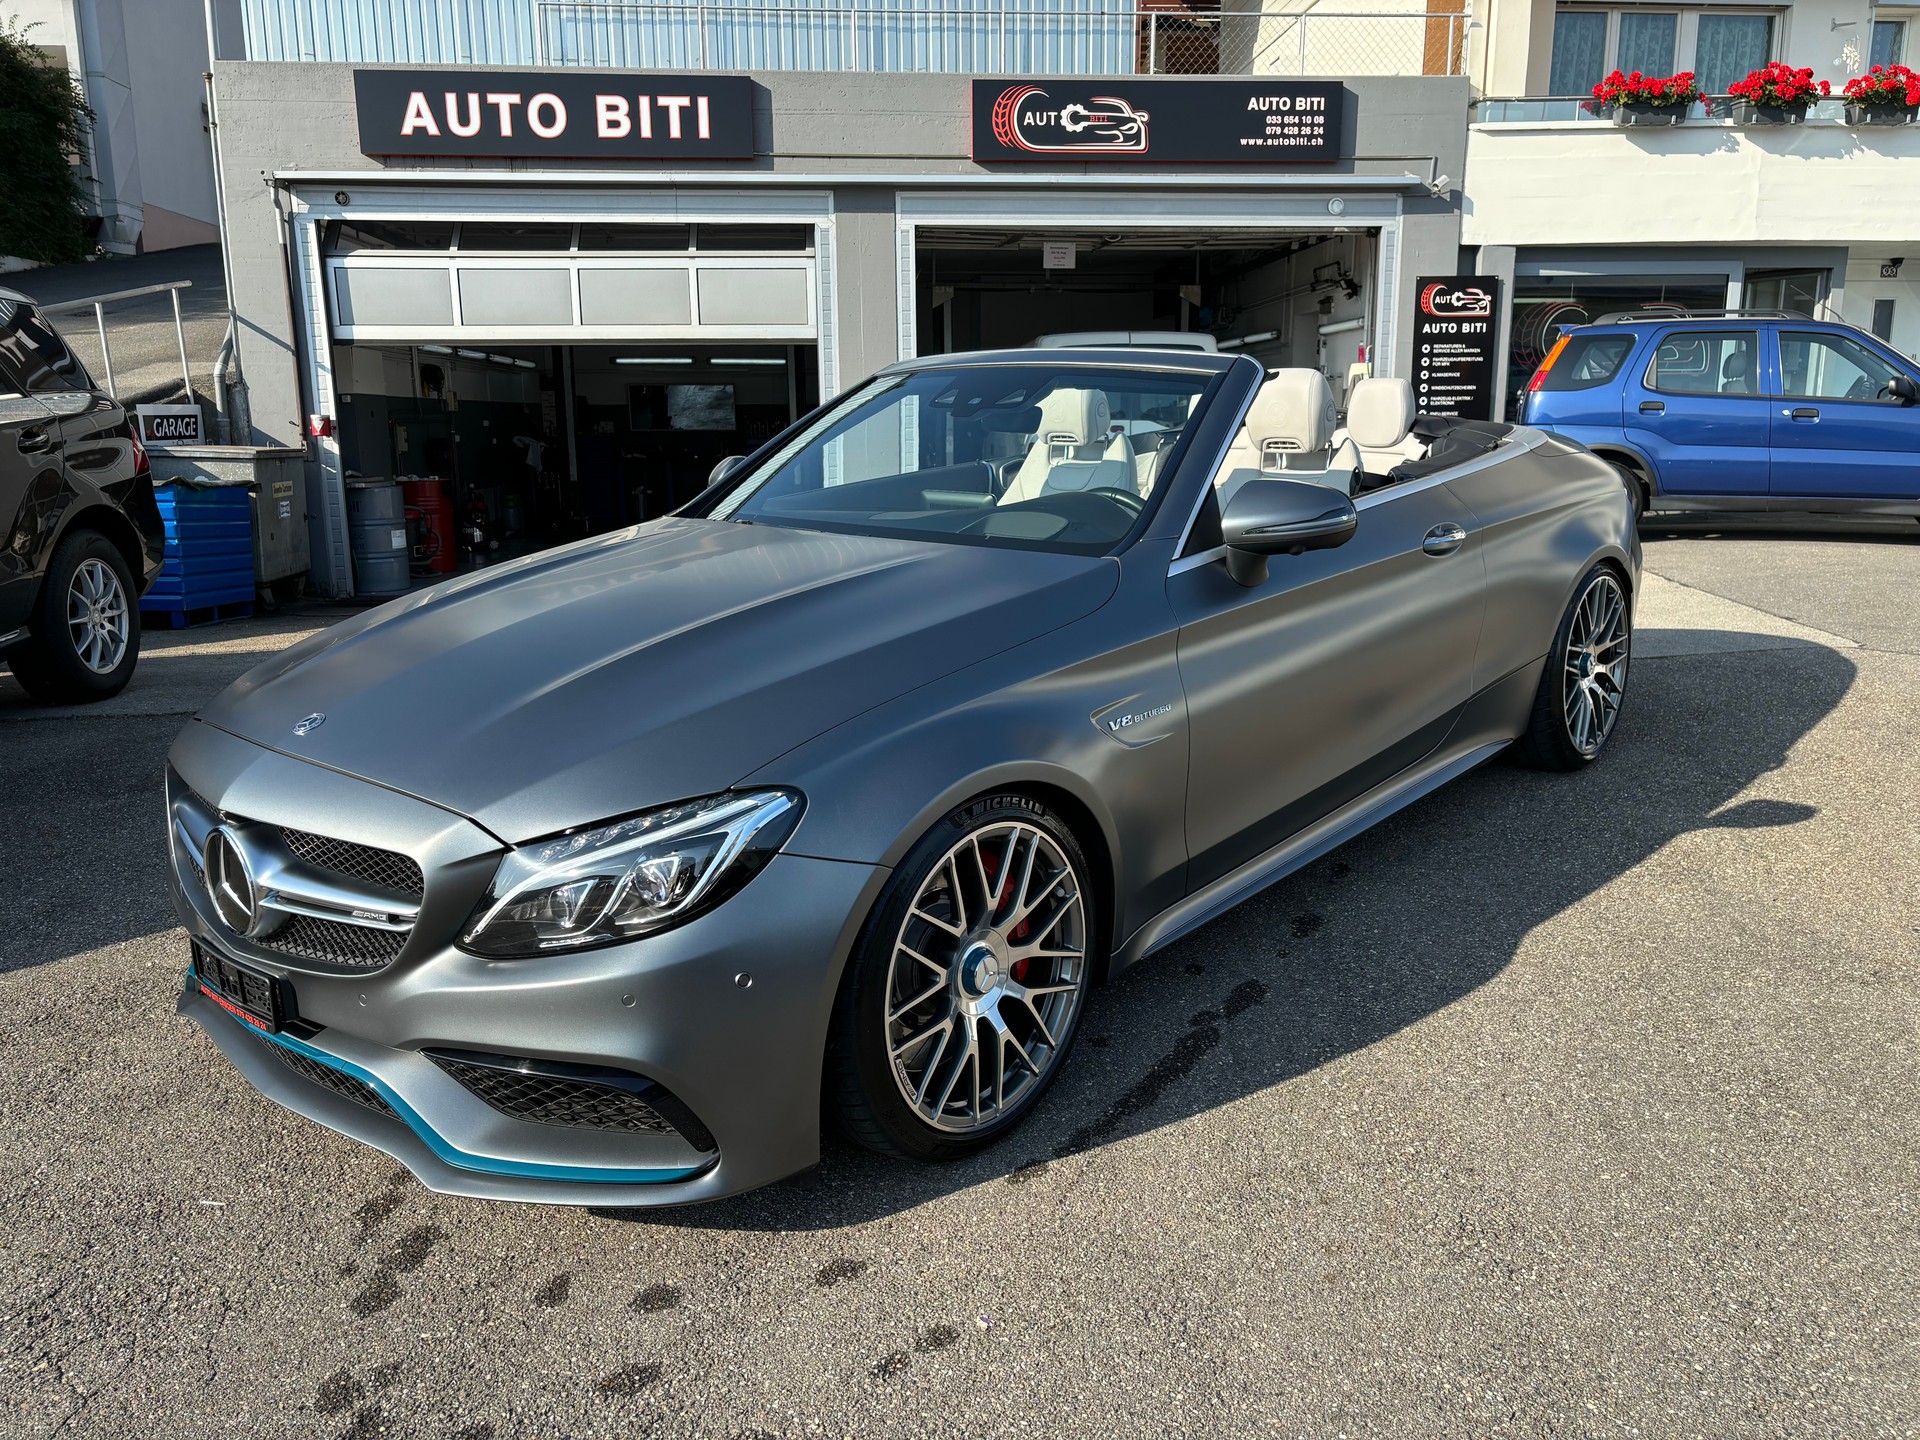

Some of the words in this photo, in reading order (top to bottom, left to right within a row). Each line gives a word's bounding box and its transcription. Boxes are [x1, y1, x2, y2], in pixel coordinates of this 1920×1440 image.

[1247, 97, 1291, 111] AUTO
[1295, 97, 1325, 111] BITI
[400, 91, 568, 139] AUTO
[595, 94, 710, 139] BITI
[1266, 116, 1281, 124] 033
[1283, 116, 1299, 124] 654
[1301, 116, 1312, 124] 10
[1313, 116, 1324, 124] 08
[1265, 126, 1281, 135] 079
[1283, 126, 1299, 135] 428
[1301, 126, 1311, 135] 26
[1313, 126, 1324, 135] 24
[1240, 137, 1324, 146] www.autobiti.ch
[1422, 323, 1457, 333] AUTO
[1462, 322, 1487, 333] BITI
[154, 418, 195, 437] GARAGE
[1108, 714, 1133, 731] V8
[1134, 703, 1172, 723] BITURBO
[972, 797, 1044, 816] MICHELIN
